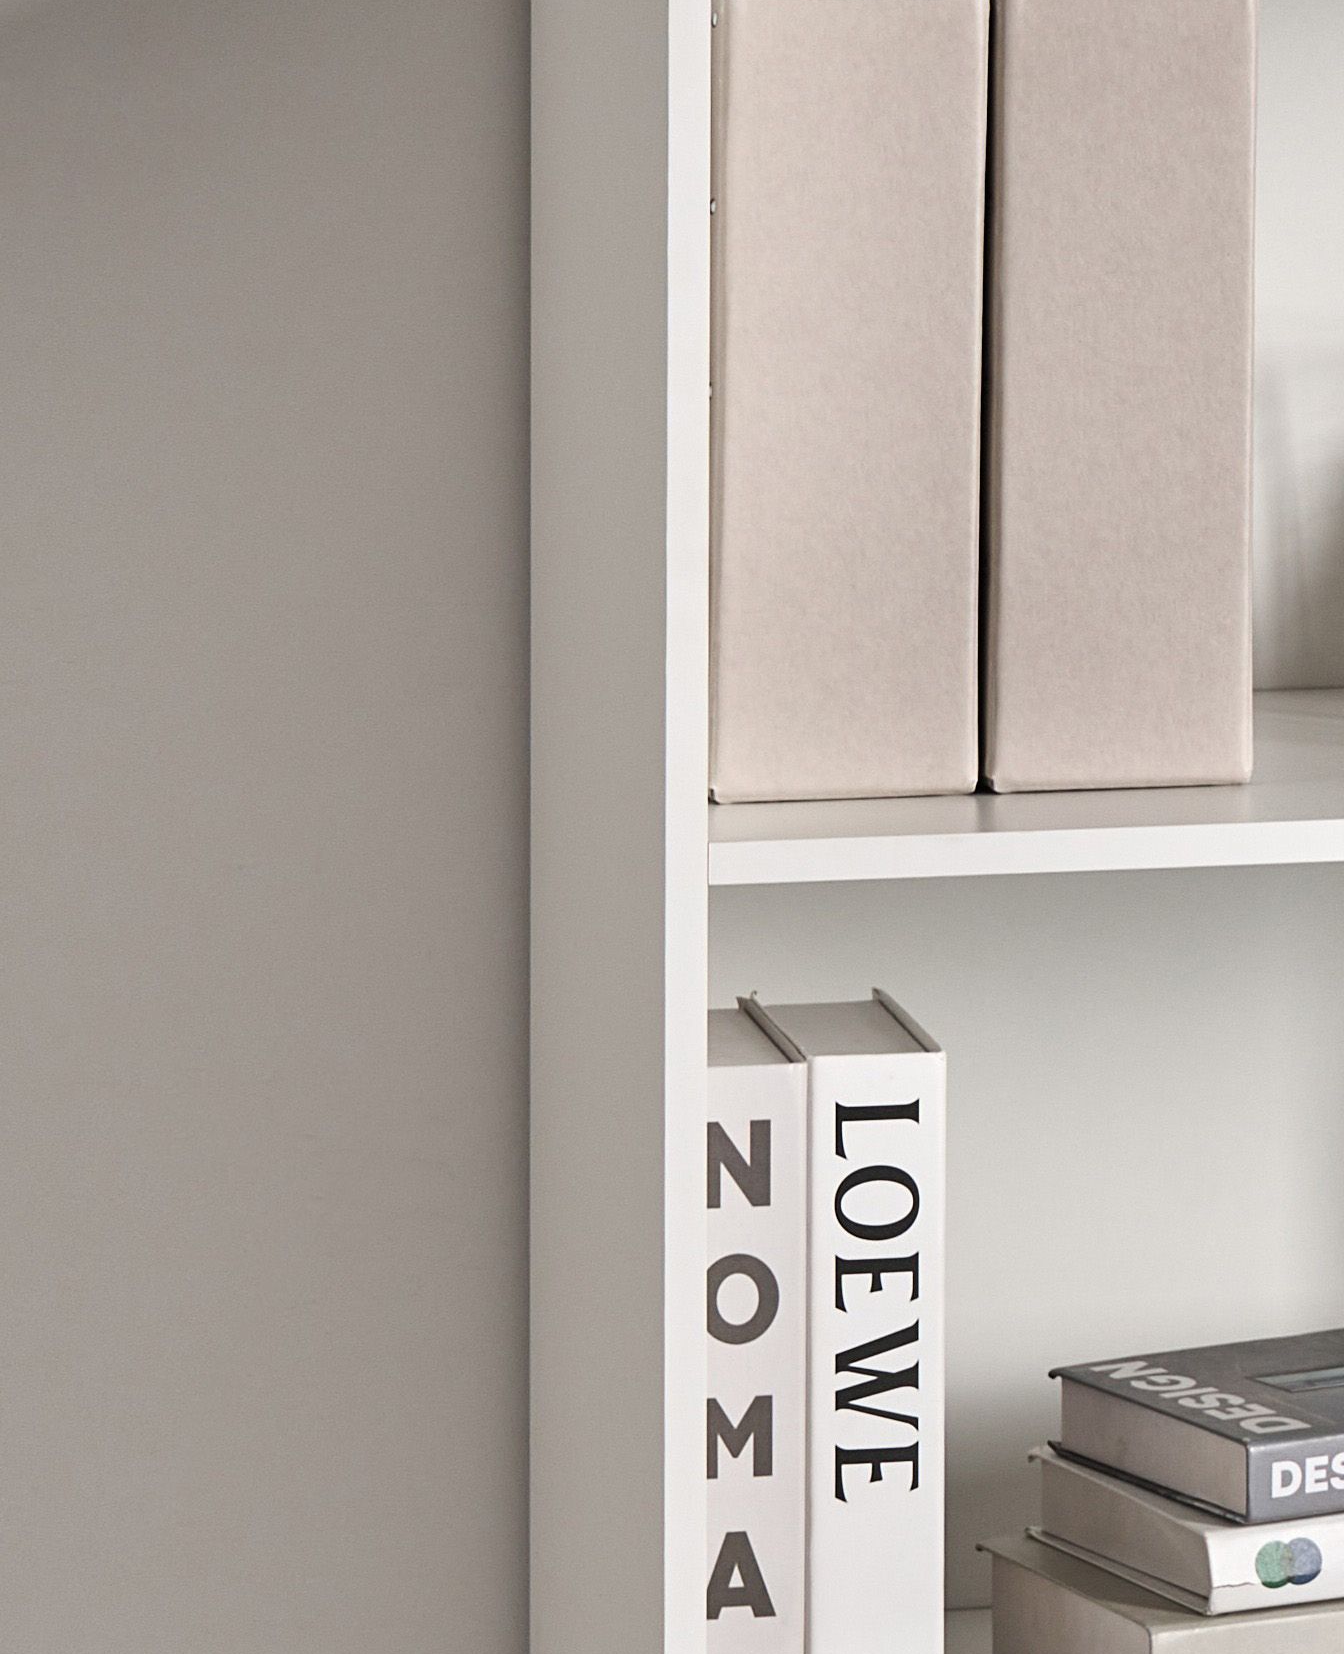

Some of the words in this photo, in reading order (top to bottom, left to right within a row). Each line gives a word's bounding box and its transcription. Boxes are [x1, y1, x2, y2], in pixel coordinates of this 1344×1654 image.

[706, 1118, 780, 1621] NOMA
[834, 1097, 920, 1504] LOEWE
[1089, 1360, 1312, 1434] DESIGN
